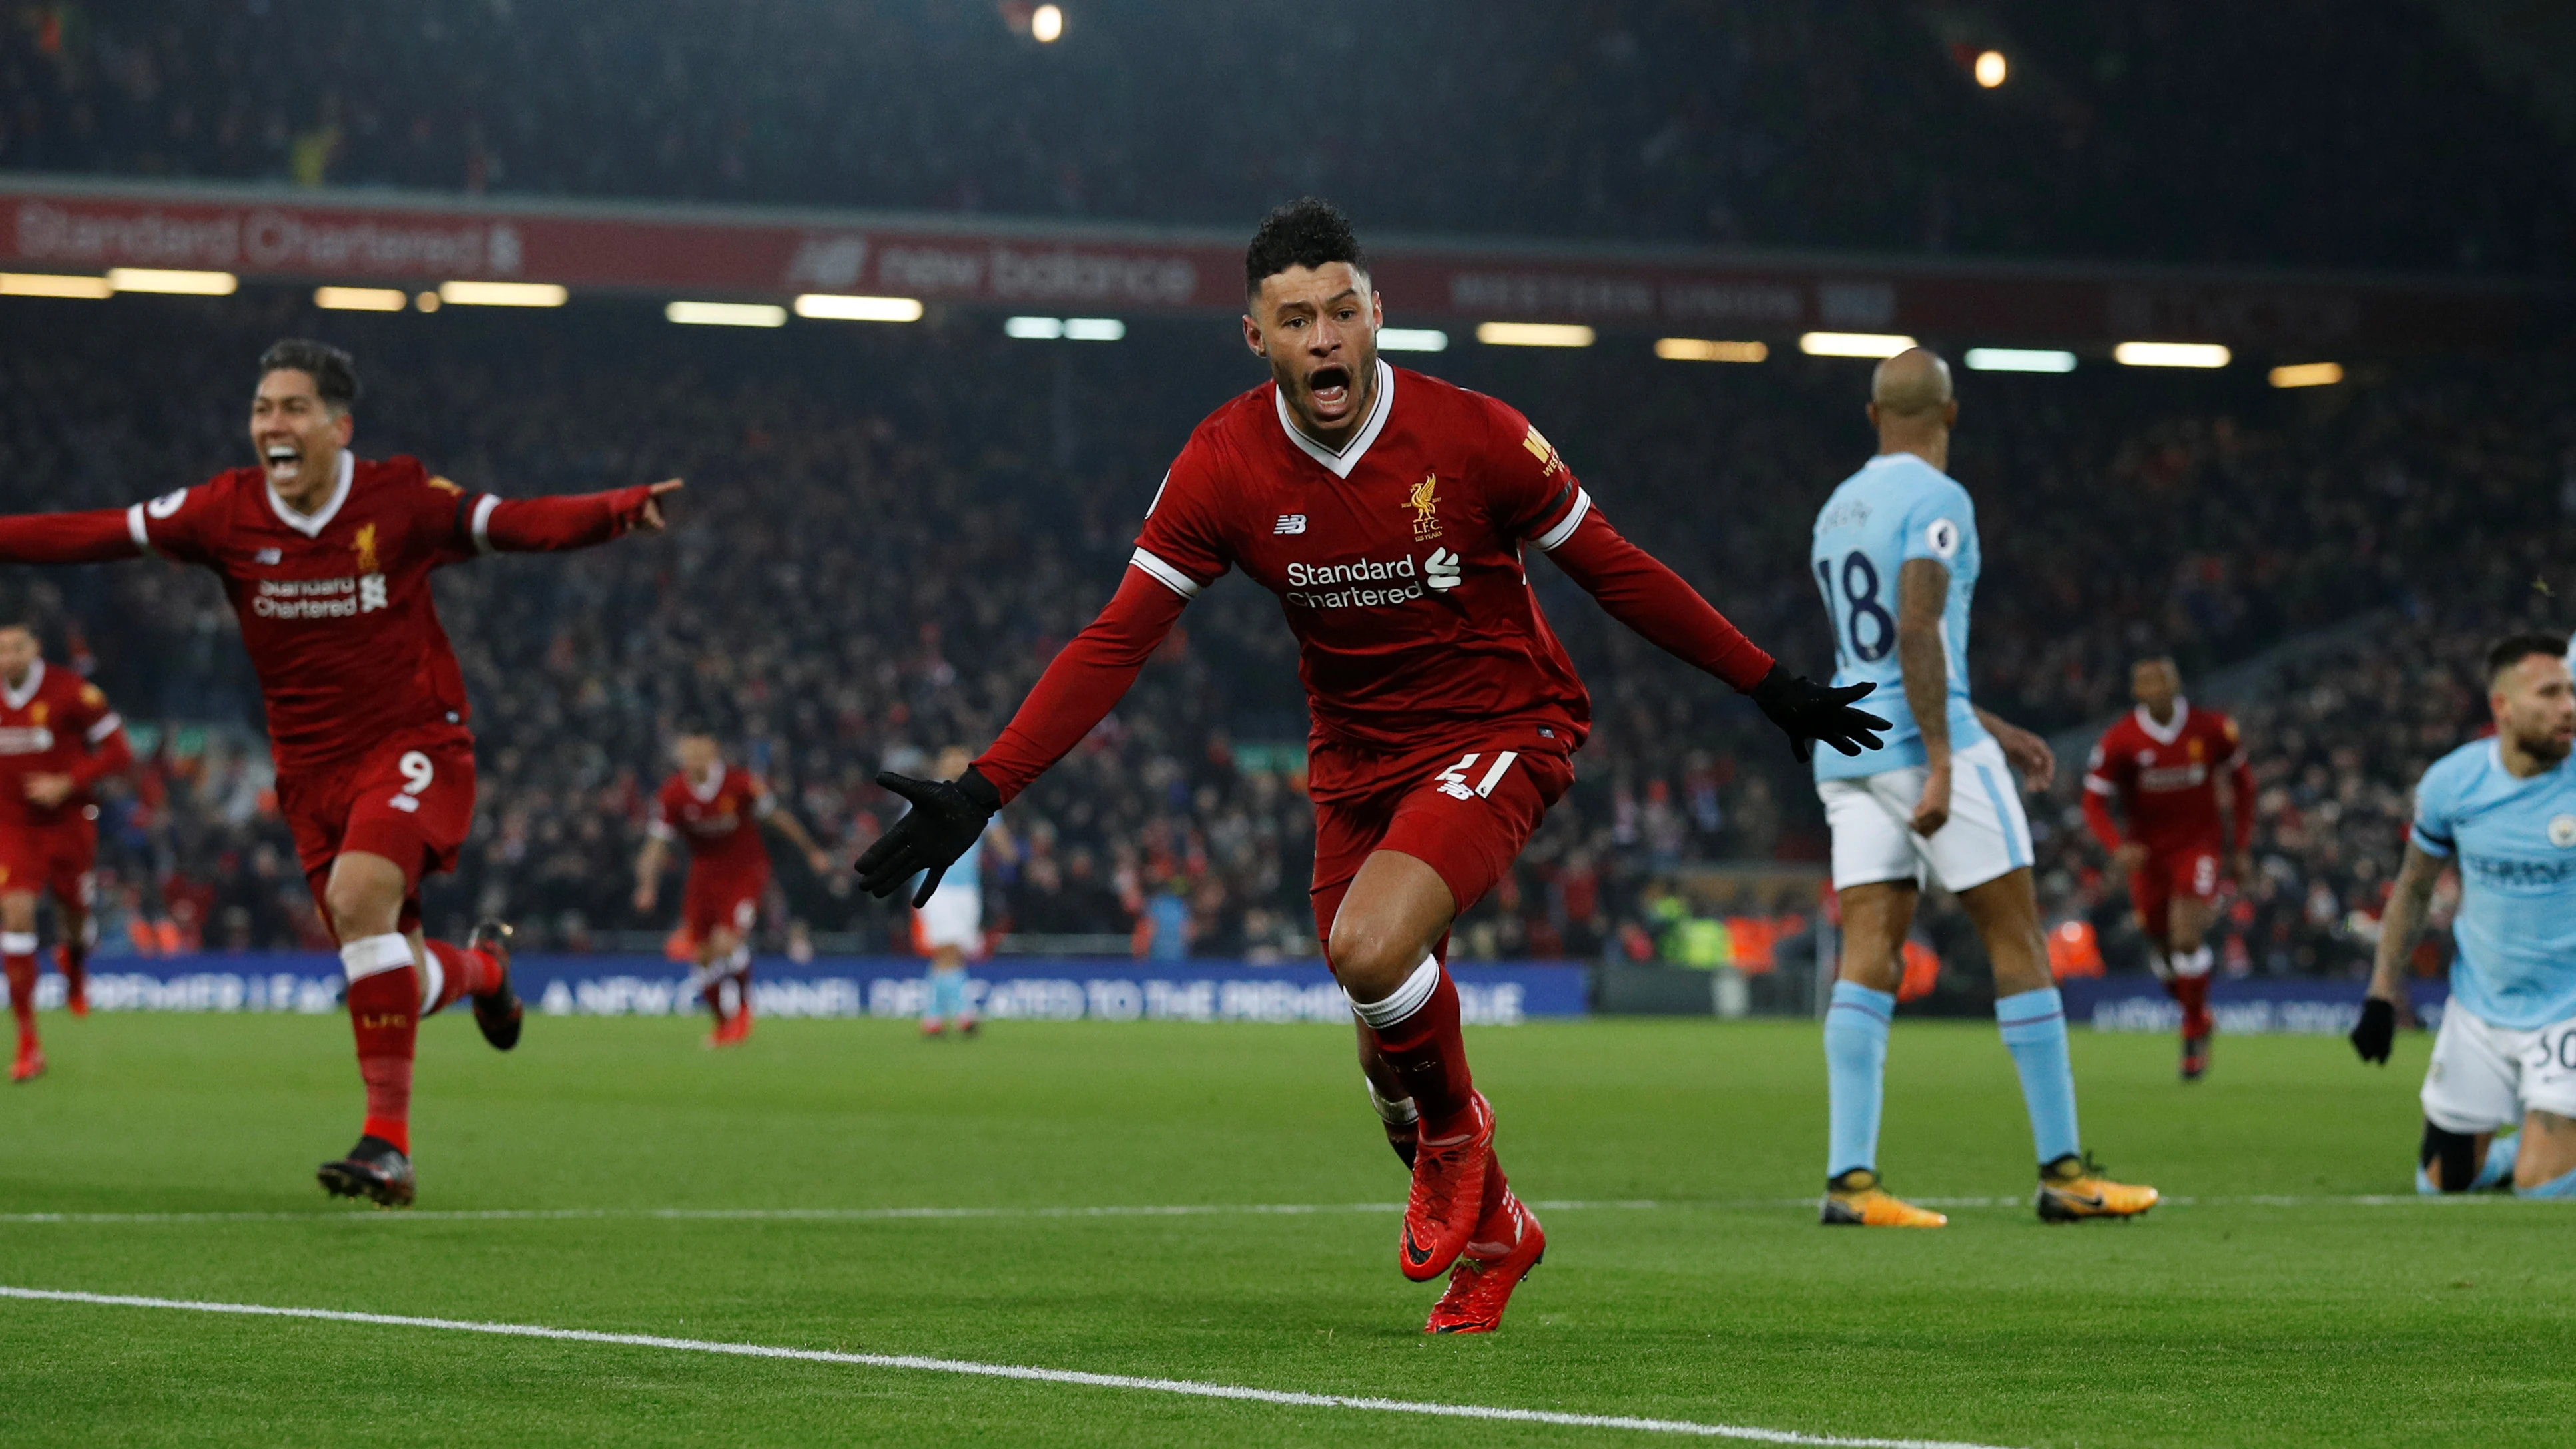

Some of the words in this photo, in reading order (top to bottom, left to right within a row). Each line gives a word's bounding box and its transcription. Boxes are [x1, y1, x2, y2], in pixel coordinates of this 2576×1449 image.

[18, 202, 240, 264] Standard
[258, 577, 355, 595] Standard
[1287, 553, 1415, 587] Standard
[253, 595, 358, 619] Chartered
[1286, 581, 1423, 609] Chartered
[1819, 551, 1894, 661] 18
[399, 750, 434, 796] 9
